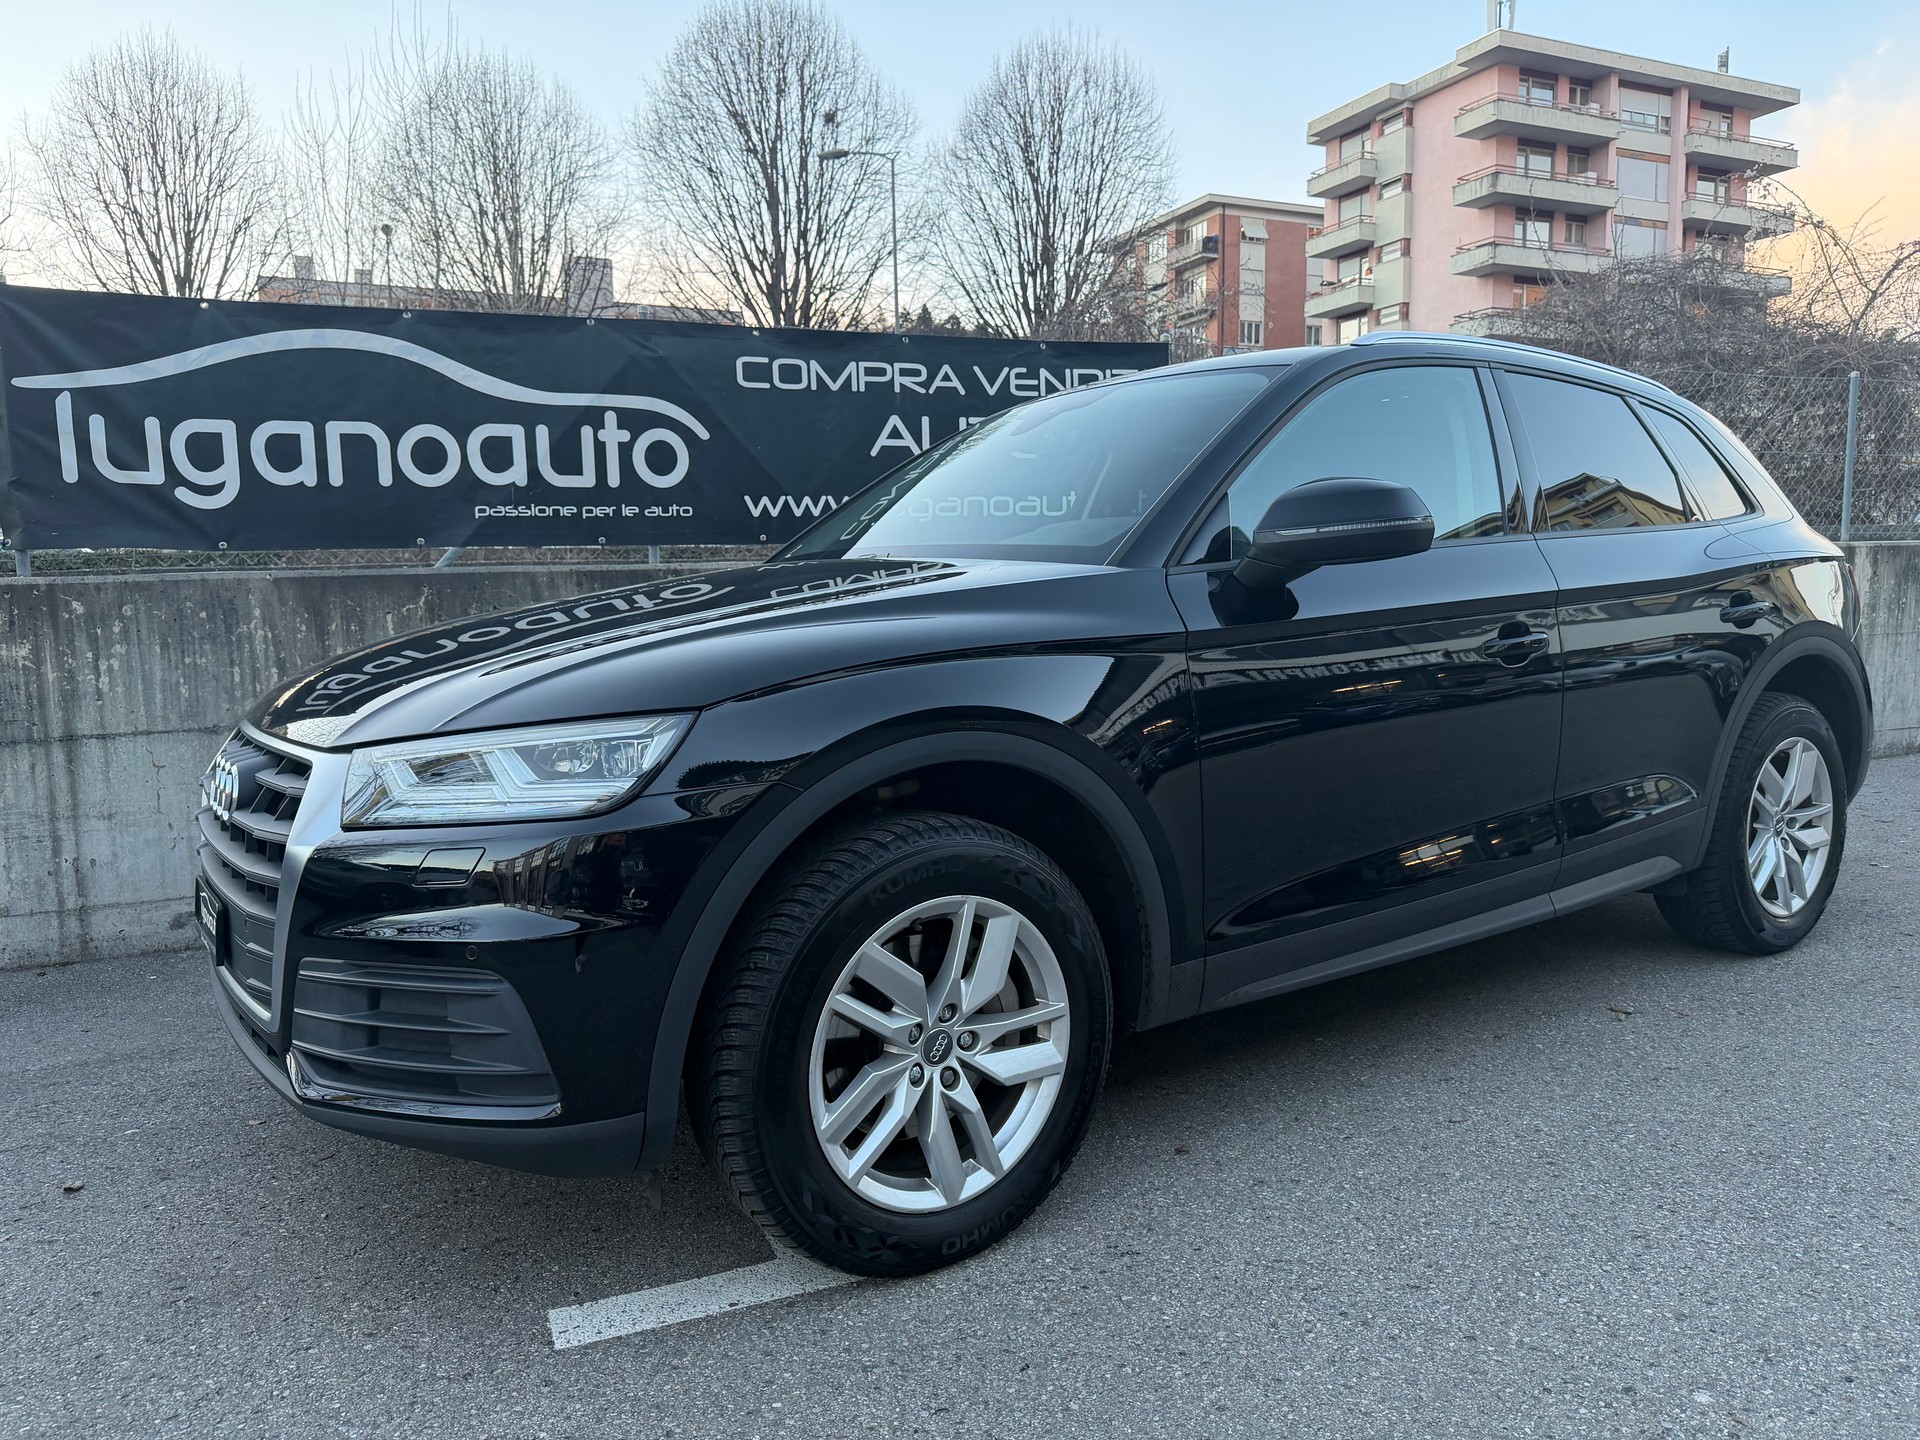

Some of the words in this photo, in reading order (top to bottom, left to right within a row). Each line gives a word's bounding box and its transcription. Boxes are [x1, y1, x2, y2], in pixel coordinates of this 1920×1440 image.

[736, 356, 966, 396] COMPRA
[55, 390, 690, 510] luganoauto
[474, 503, 577, 519] passione
[582, 505, 617, 519] per
[621, 503, 640, 517] le
[644, 503, 693, 517] auto
[868, 854, 968, 907] KUMHO
